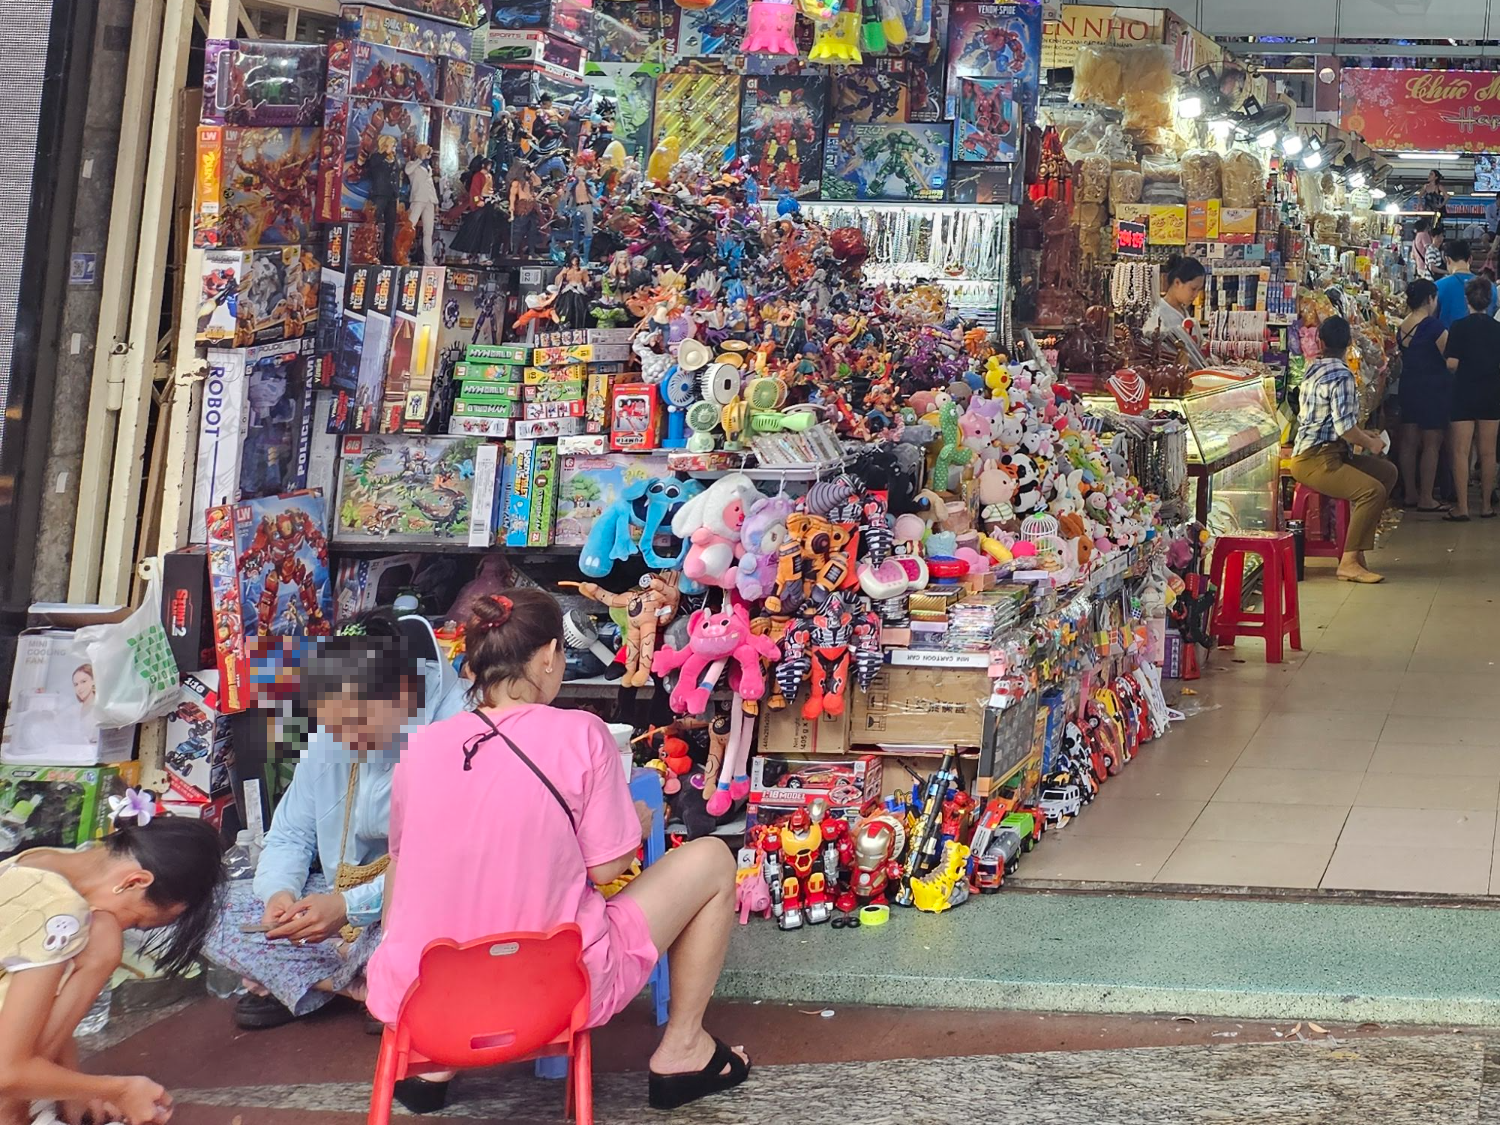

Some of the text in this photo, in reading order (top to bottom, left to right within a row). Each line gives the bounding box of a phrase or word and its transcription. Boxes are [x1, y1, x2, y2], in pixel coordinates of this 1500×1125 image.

[1405, 74, 1472, 104] Chúc
[205, 367, 225, 437] ROBOT
[237, 509, 251, 521] LW
[28, 640, 48, 648] MINI
[27, 648, 67, 656] COOLING
[25, 656, 44, 664] FAN
[778, 792, 807, 801] MODEL
